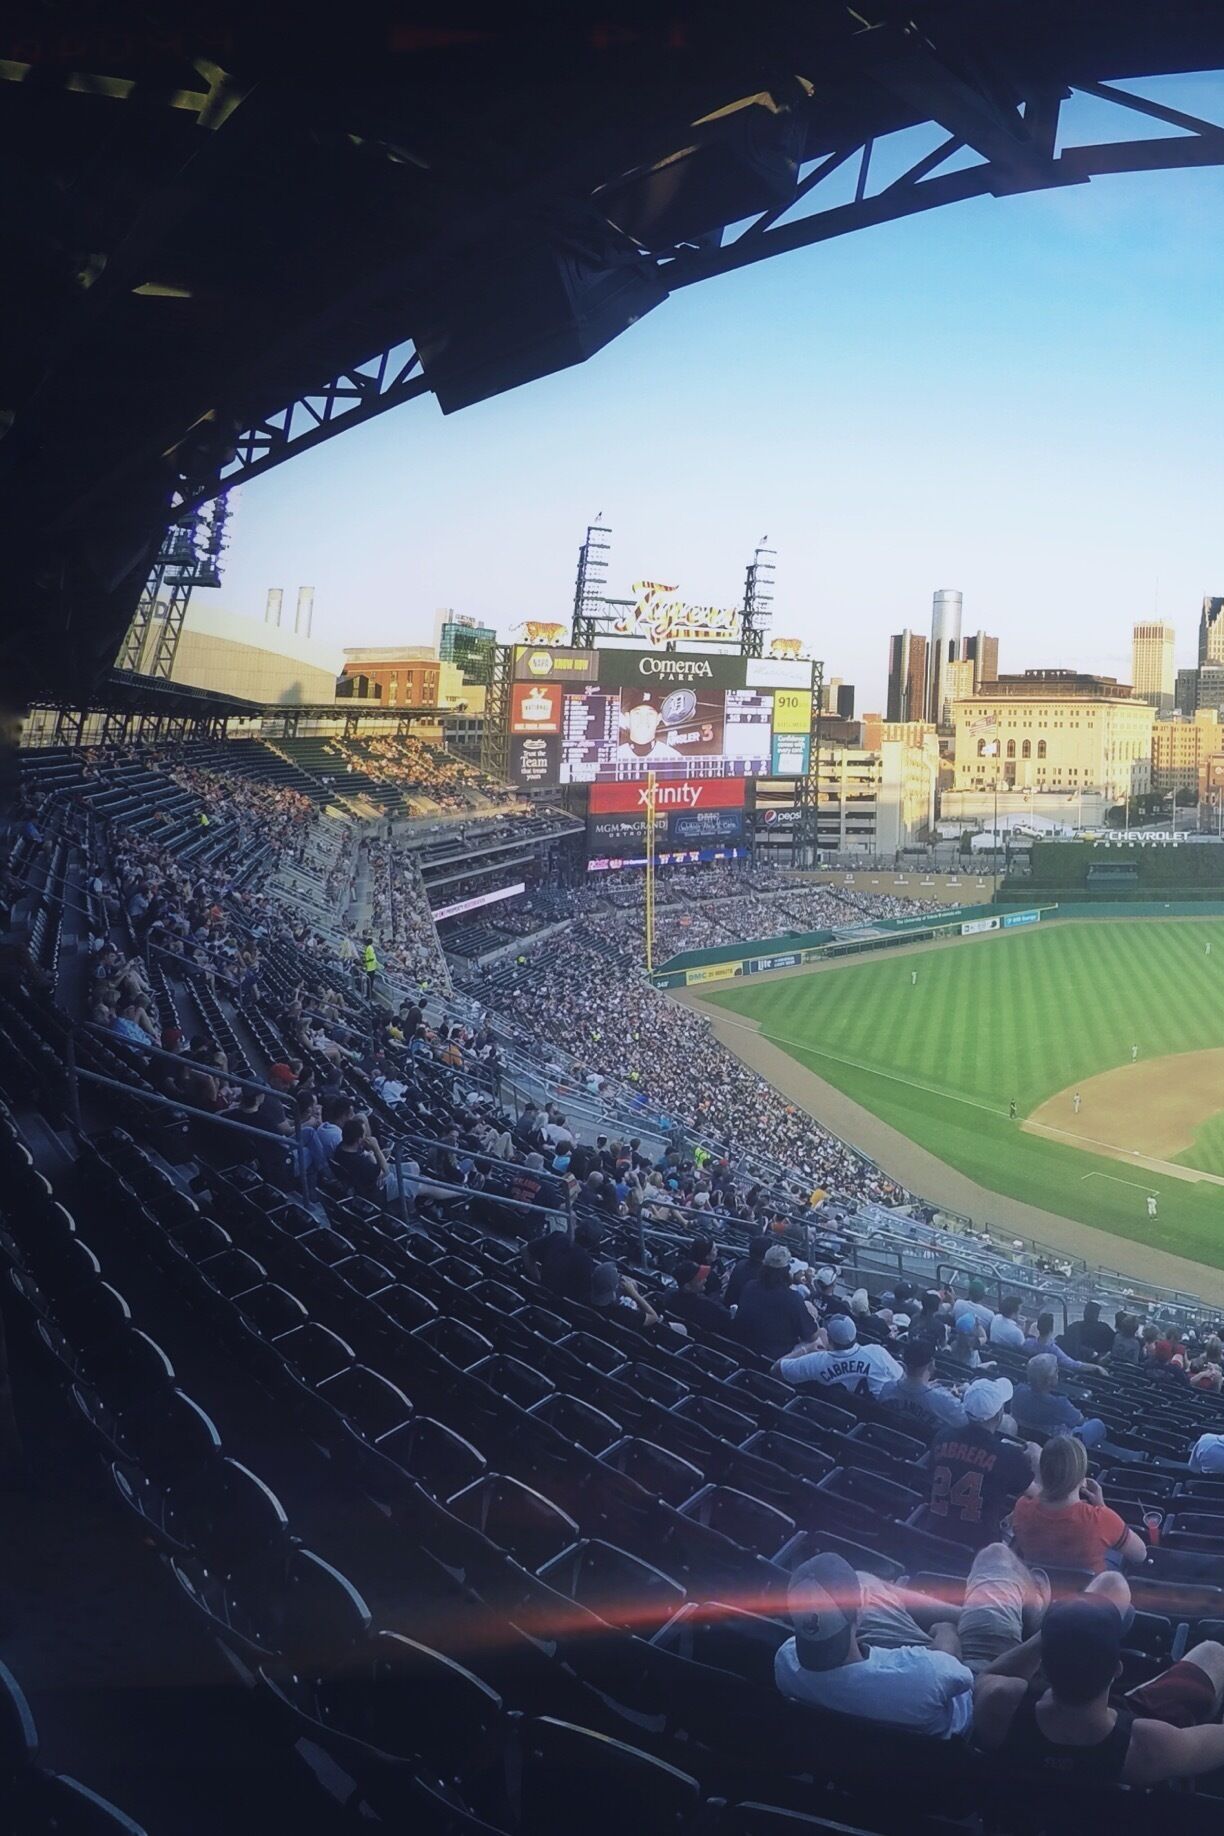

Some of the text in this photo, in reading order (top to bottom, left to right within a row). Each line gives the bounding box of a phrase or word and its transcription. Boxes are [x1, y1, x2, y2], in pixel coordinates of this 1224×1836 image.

[778, 697, 798, 708] 910
[702, 724, 714, 742] 3
[520, 756, 548, 768] Team
[638, 782, 703, 808] xfinity
[778, 811, 801, 822] pepsi
[596, 820, 666, 832] MGM GRAND
[1109, 832, 1190, 840] CHEVROLET
[820, 1360, 871, 1382] CABRERA
[930, 1466, 984, 1522] 24
